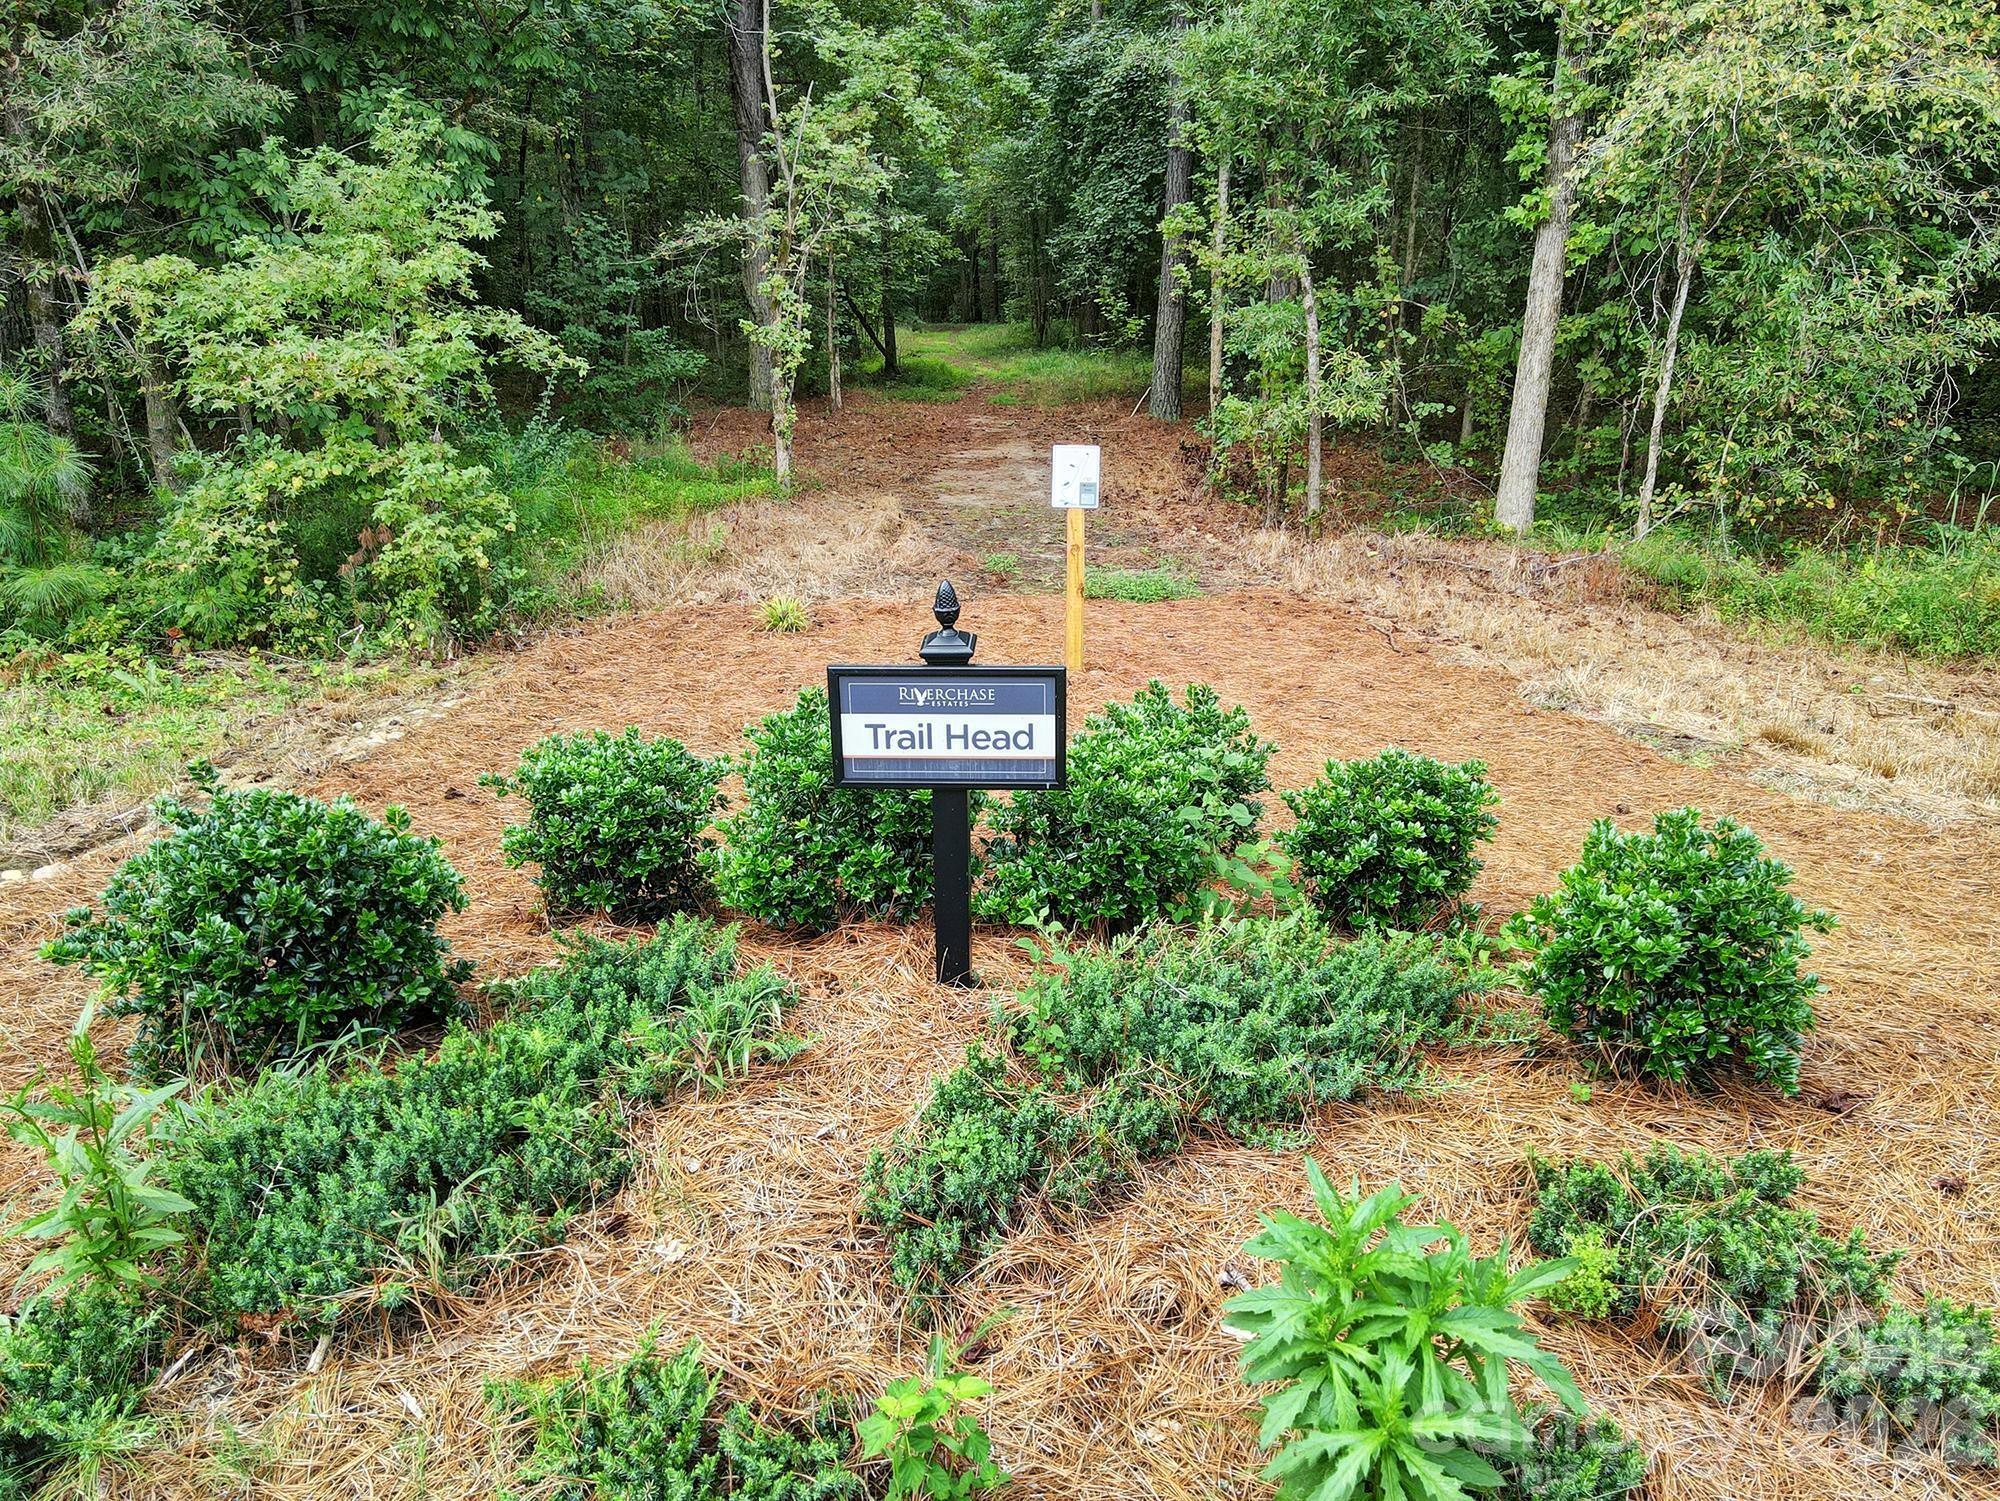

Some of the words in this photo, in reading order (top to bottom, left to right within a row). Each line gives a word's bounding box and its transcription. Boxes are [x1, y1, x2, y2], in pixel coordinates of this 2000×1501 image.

[898, 687, 995, 701] RIVERCHASE
[864, 723, 933, 750] Trail
[946, 723, 1034, 750] Head
